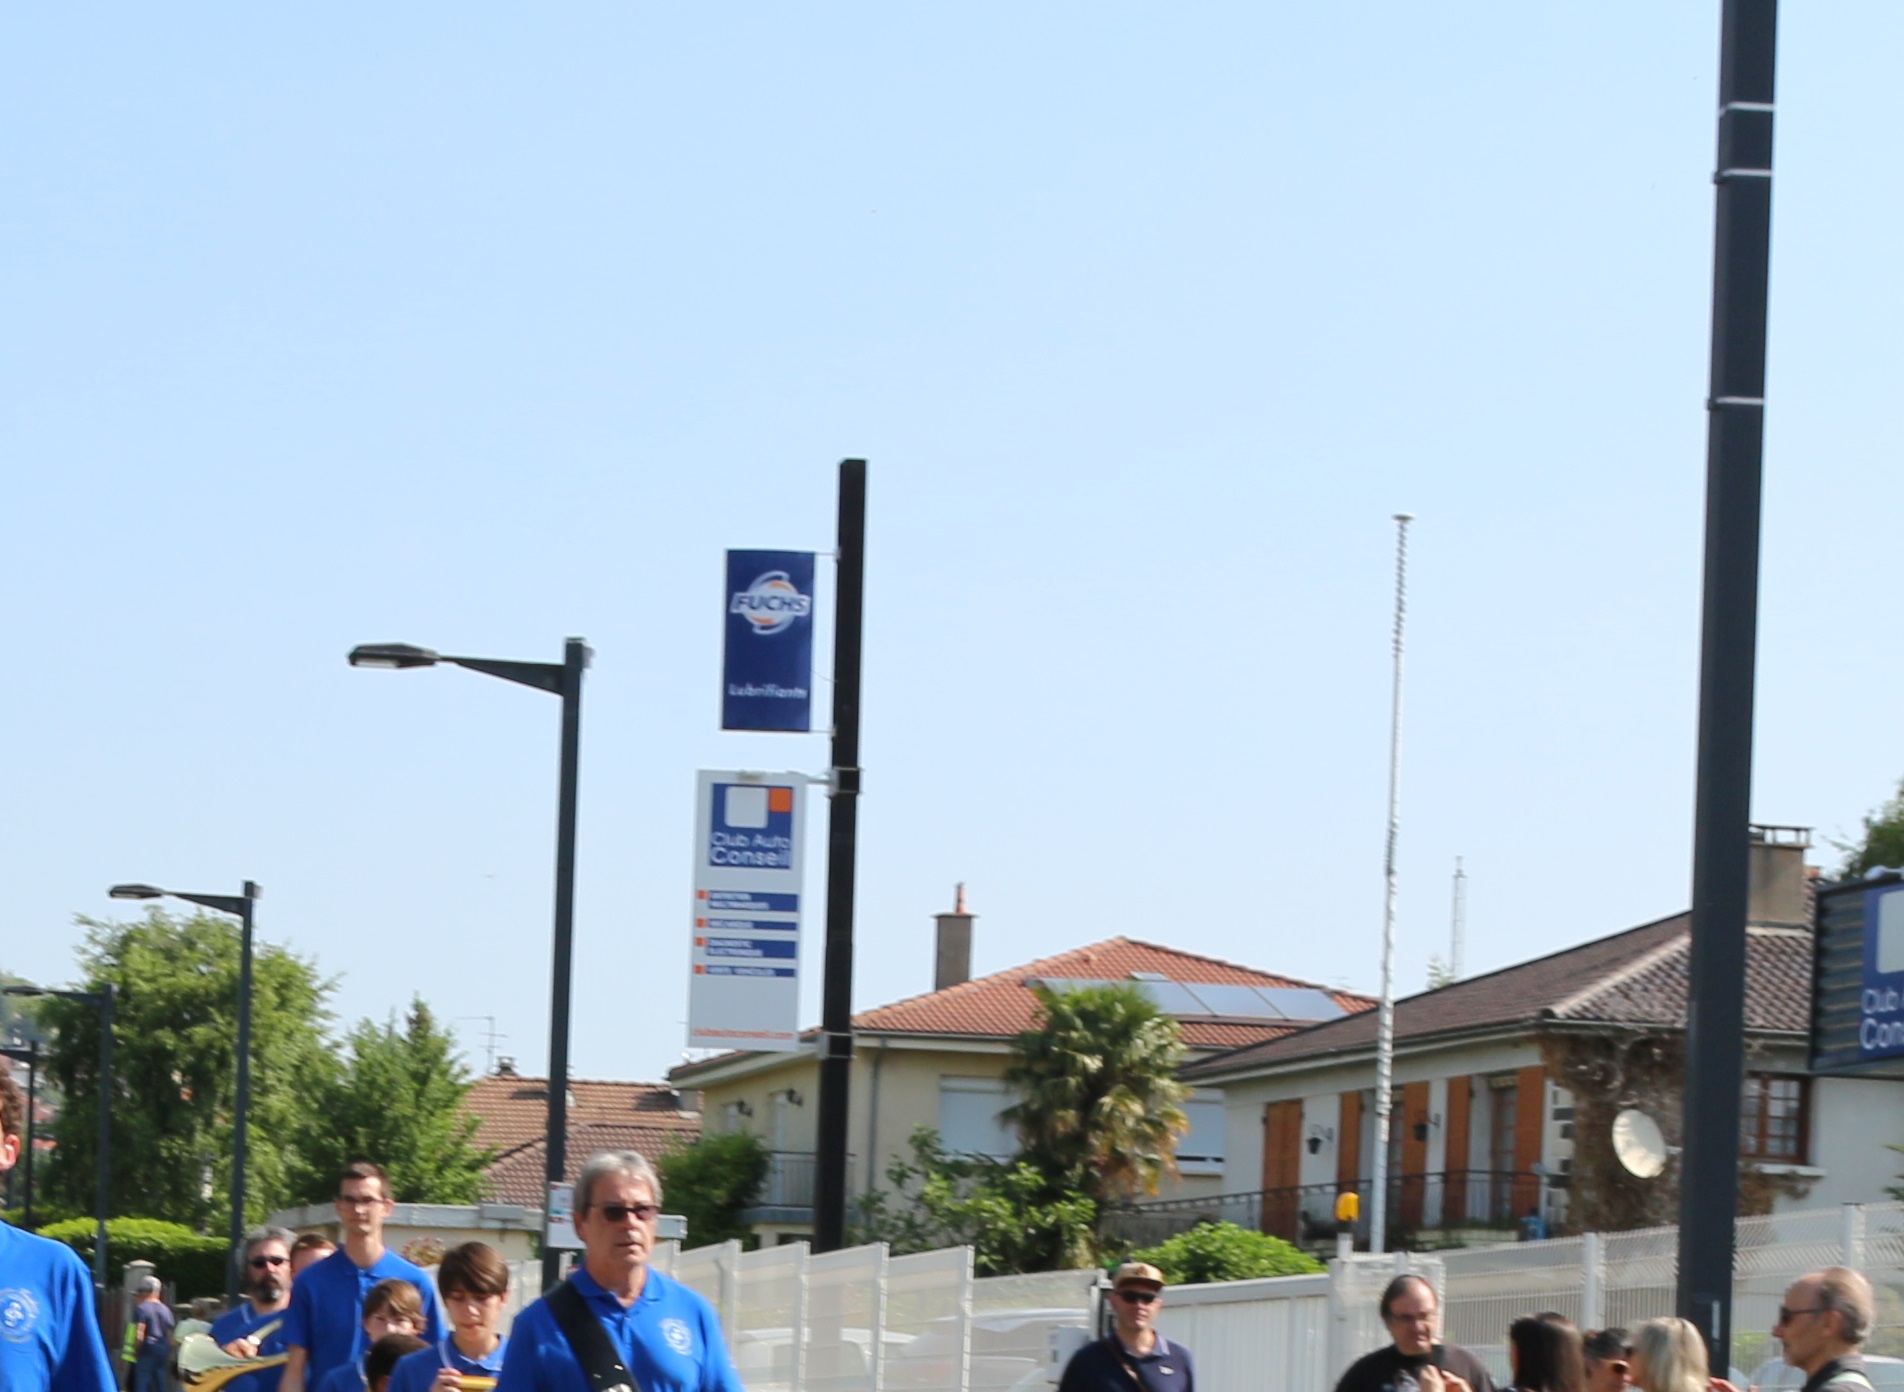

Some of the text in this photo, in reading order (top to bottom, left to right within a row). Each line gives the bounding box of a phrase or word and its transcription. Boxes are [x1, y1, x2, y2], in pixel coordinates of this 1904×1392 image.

[734, 594, 810, 613] FUCHS
[711, 831, 750, 847] Club
[1861, 987, 1900, 1014] Club
